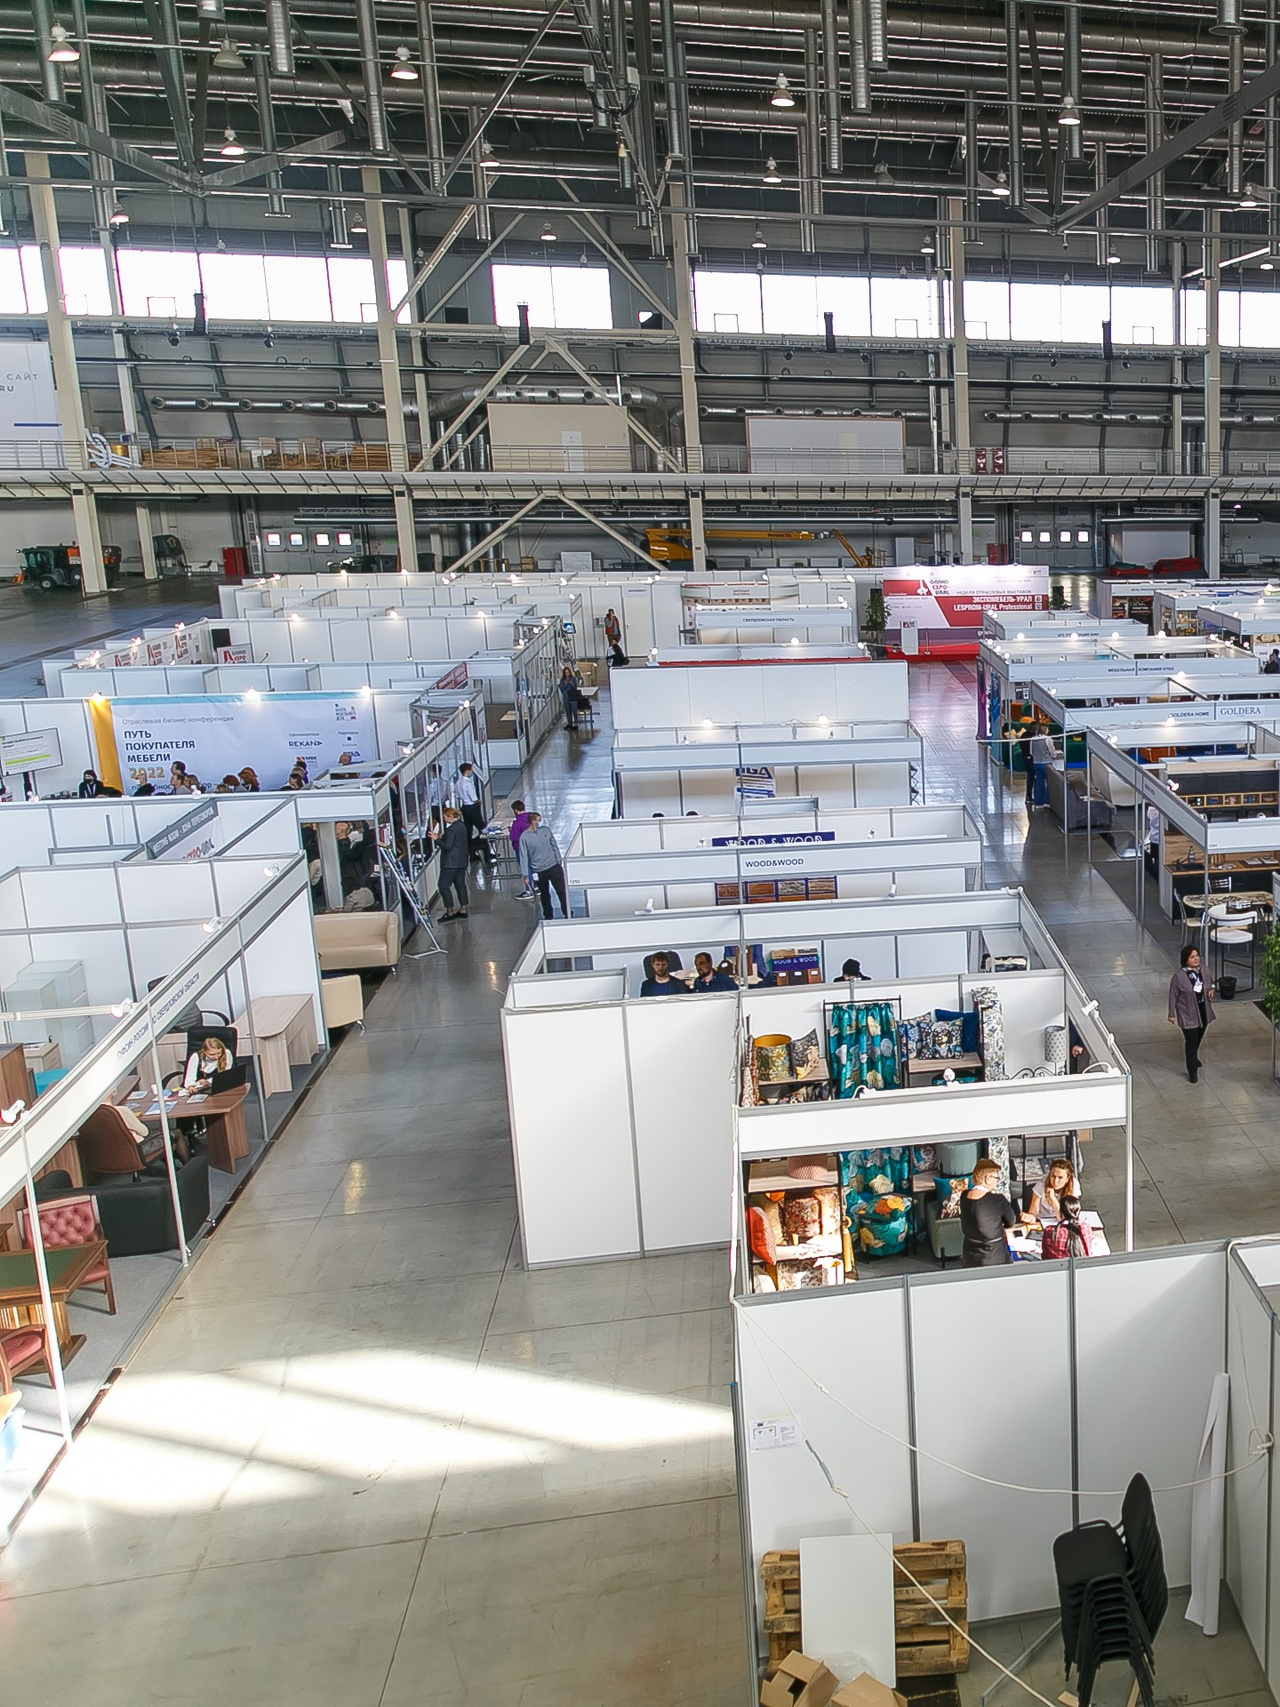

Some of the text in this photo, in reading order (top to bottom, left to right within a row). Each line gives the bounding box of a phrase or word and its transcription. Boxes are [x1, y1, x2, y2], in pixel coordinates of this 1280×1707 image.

[7, 373, 38, 381] САЙТ
[1220, 706, 1261, 716] GOLDERA
[162, 716, 234, 724] бизнес-конференция
[124, 730, 152, 739] ПУТЬ
[125, 740, 196, 750] ПОКУПАТЕЛЯ
[127, 753, 171, 763] МЕБЕЛИ
[153, 836, 168, 853] MEETING
[168, 829, 179, 842] ROOM
[745, 858, 804, 868] WOOD&WOOD
[117, 1038, 133, 1060] ГУФСИН
[133, 1022, 149, 1042] РОССИИ
[156, 986, 184, 1020] СВЕРДЛОВСКОЙ
[184, 972, 200, 992] ОБЛАСТИ
